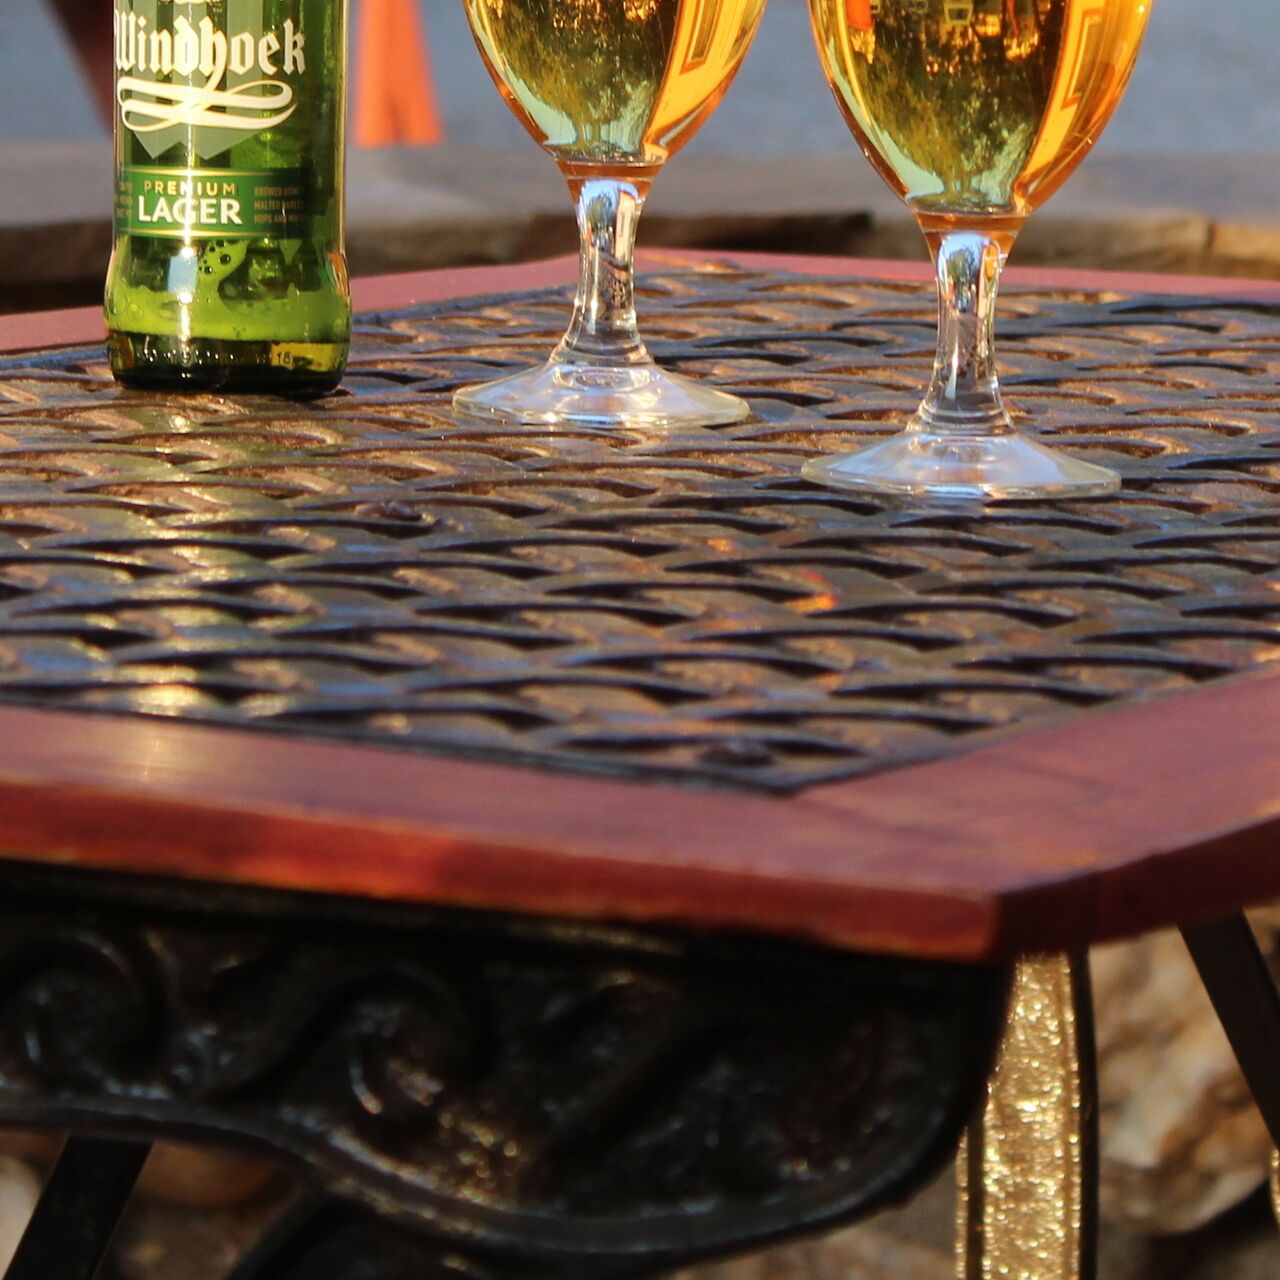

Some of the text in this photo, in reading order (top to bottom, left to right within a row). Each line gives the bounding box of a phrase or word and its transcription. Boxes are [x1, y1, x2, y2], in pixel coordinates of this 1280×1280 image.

[115, 10, 306, 95] Windhoek
[144, 180, 236, 196] PREMIUM
[138, 195, 243, 225] LAGER
